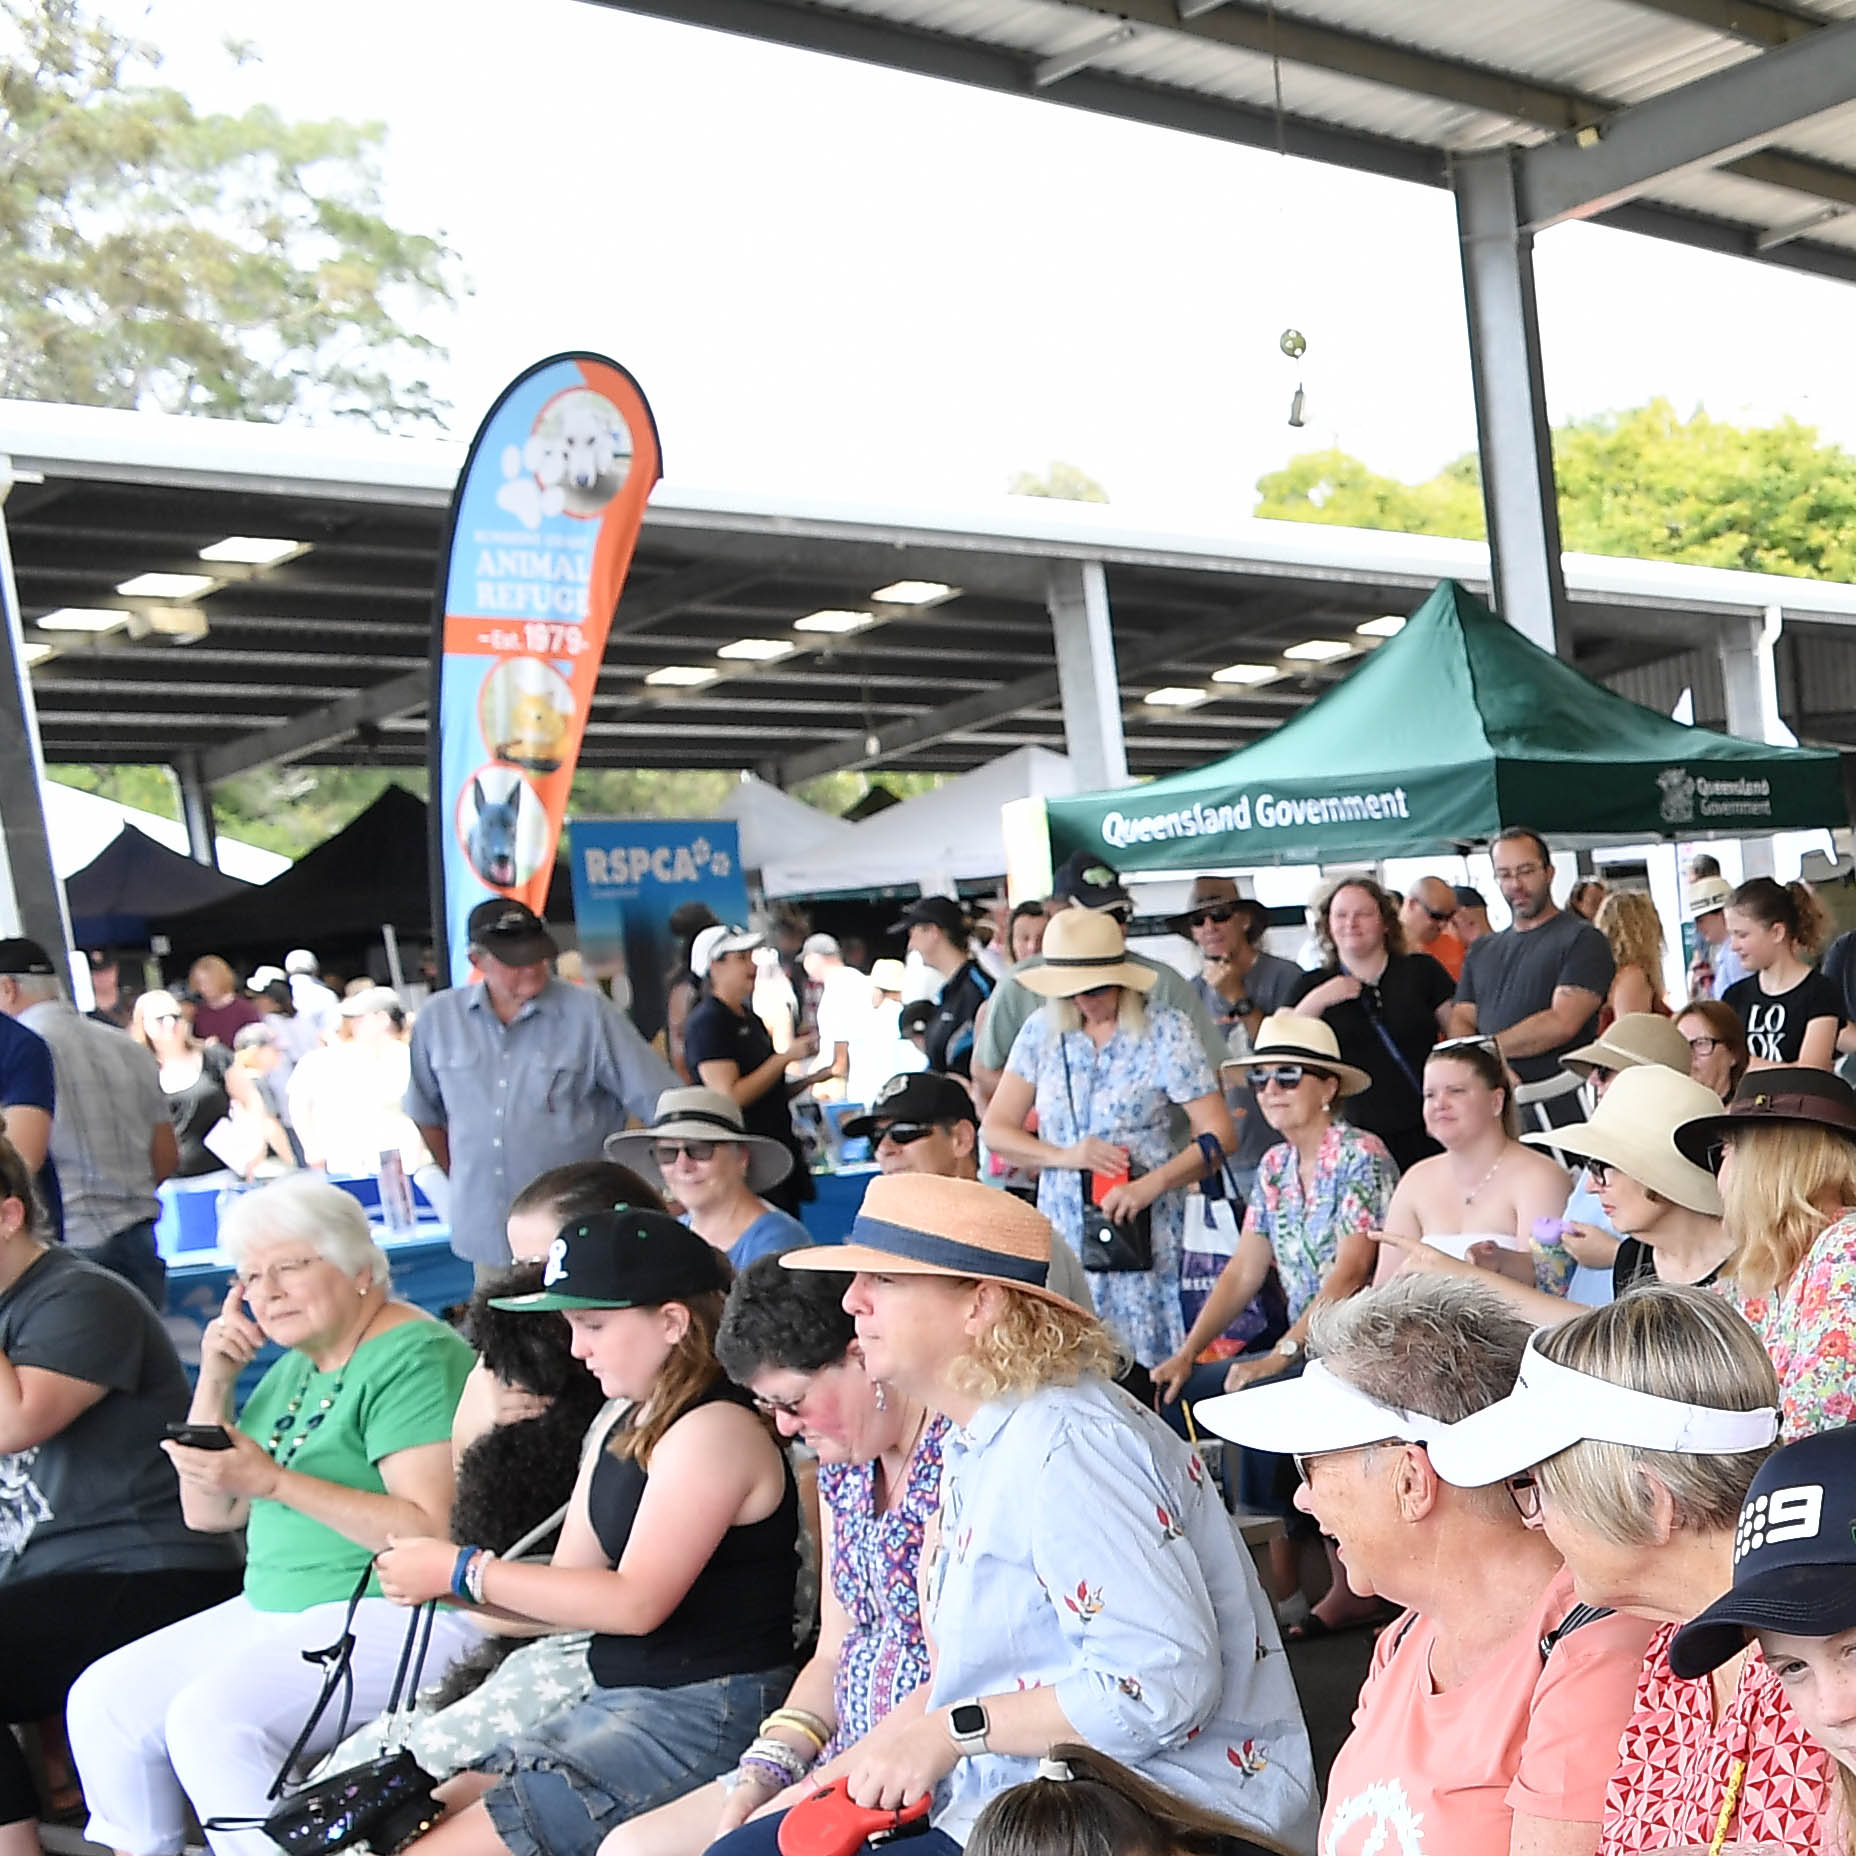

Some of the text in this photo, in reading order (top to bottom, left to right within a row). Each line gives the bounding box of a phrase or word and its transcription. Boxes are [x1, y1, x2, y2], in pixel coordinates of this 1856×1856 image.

[477, 548, 590, 582] ANIMAL
[476, 581, 590, 617] REFUGE
[1696, 776, 1770, 797] Queensland
[1102, 787, 1411, 848] Queensland Government
[1700, 799, 1772, 816] Government
[585, 846, 698, 883] RSPCA
[1748, 1004, 1785, 1033] LO
[1765, 1484, 1824, 1544] 9
